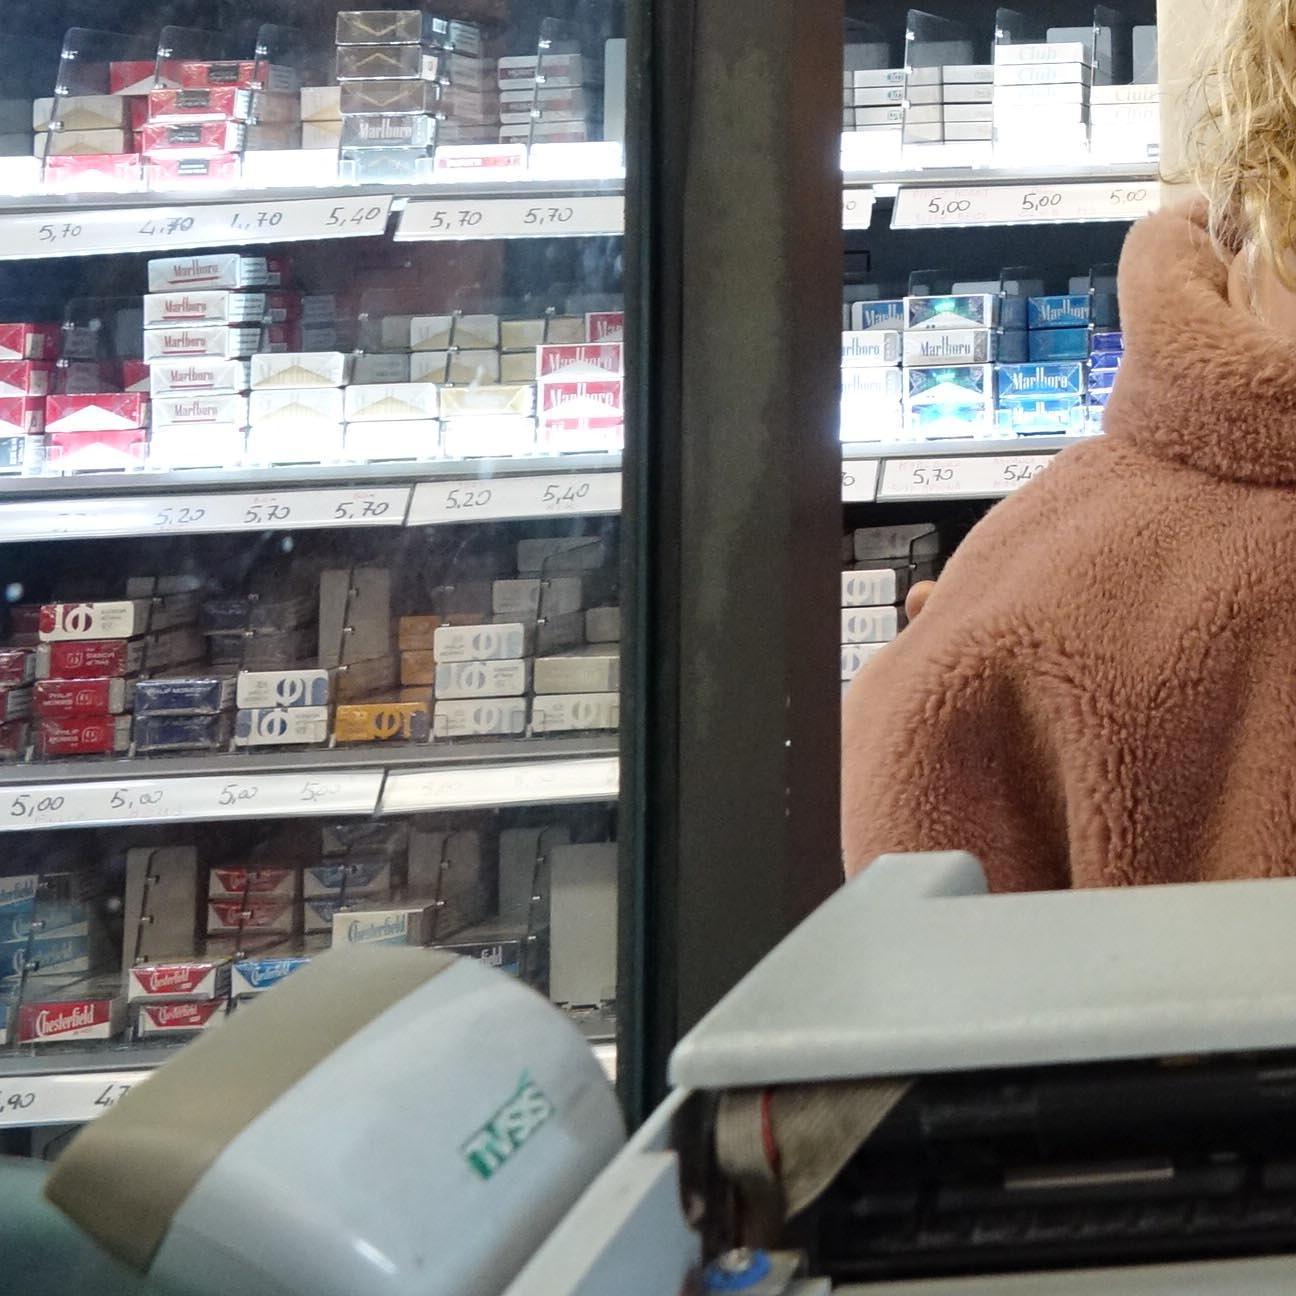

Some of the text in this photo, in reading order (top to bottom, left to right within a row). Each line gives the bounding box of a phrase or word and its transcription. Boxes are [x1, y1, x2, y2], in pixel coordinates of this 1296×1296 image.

[359, 118, 412, 140] Marlboro
[173, 259, 218, 277] Marlboro
[165, 297, 207, 313] Marlboro
[164, 332, 206, 347] Marlboro
[921, 335, 971, 357] Marlboro
[170, 366, 214, 382] Marlboro
[1013, 366, 1068, 390] Marlboro
[174, 401, 218, 417] Marlboro
[150, 969, 189, 990] Chesterfield
[35, 1005, 94, 1037] Chesterfield
[158, 1004, 198, 1024] Chesterfield
